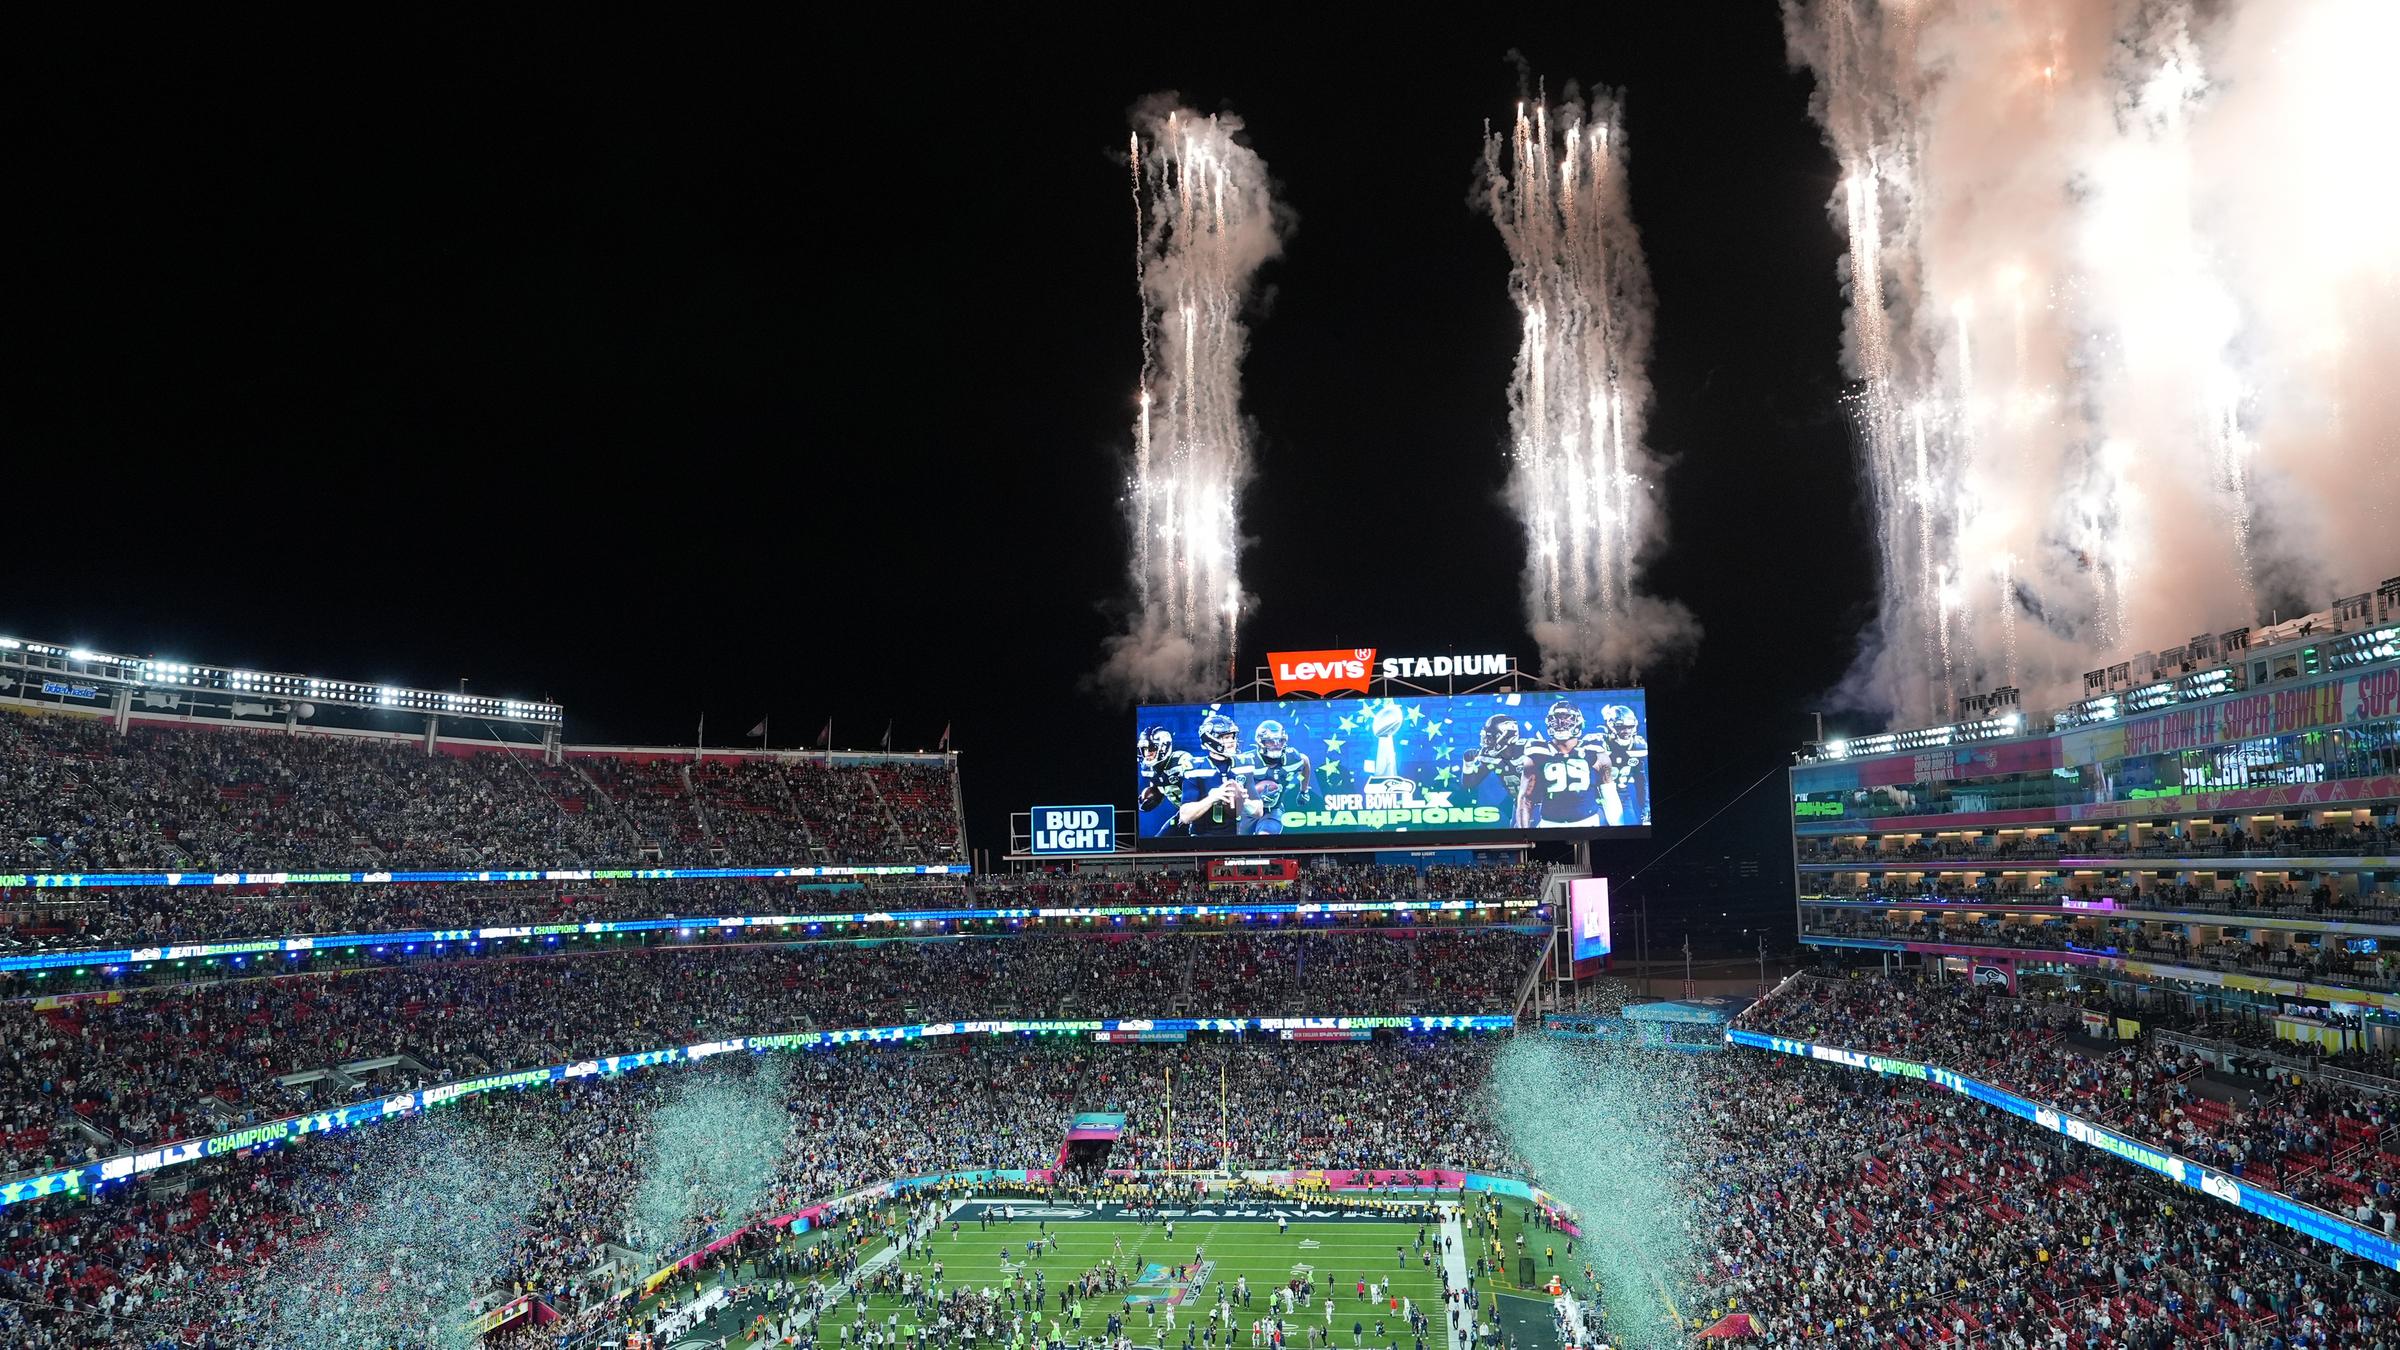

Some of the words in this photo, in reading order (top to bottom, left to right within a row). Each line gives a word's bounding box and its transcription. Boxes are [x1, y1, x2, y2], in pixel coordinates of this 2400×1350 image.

[1383, 654, 1507, 679] STADIUM
[2223, 694, 2270, 741] SUPER
[2274, 684, 2318, 731] BOWL
[2321, 678, 2345, 725] LX
[2123, 718, 2160, 756] SUPER
[2162, 711, 2197, 749] BOWL
[2199, 705, 2215, 745] LX
[1544, 758, 1591, 793] 99
[1324, 794, 1363, 811] SUPER
[1366, 792, 1401, 809] BOWL
[1402, 791, 1454, 808] LX
[1046, 810, 1100, 830] BUD
[1281, 806, 1500, 828] CHAMPIONS
[593, 870, 633, 879] CHAMPIONS
[1093, 907, 1141, 916] HAMPIONS
[534, 924, 579, 936] CHAMPIONS
[169, 944, 209, 959] SEATTLE
[207, 942, 280, 955] SEAHAWKS
[1306, 1017, 1337, 1029] LX
[748, 1033, 822, 1050] CHAMPIONS
[1128, 1032, 1185, 1040] SEAHAWKS
[459, 1069, 550, 1095] SEAHAWKS
[207, 1122, 288, 1155] CHAMPIONS
[163, 1142, 203, 1166] LX
